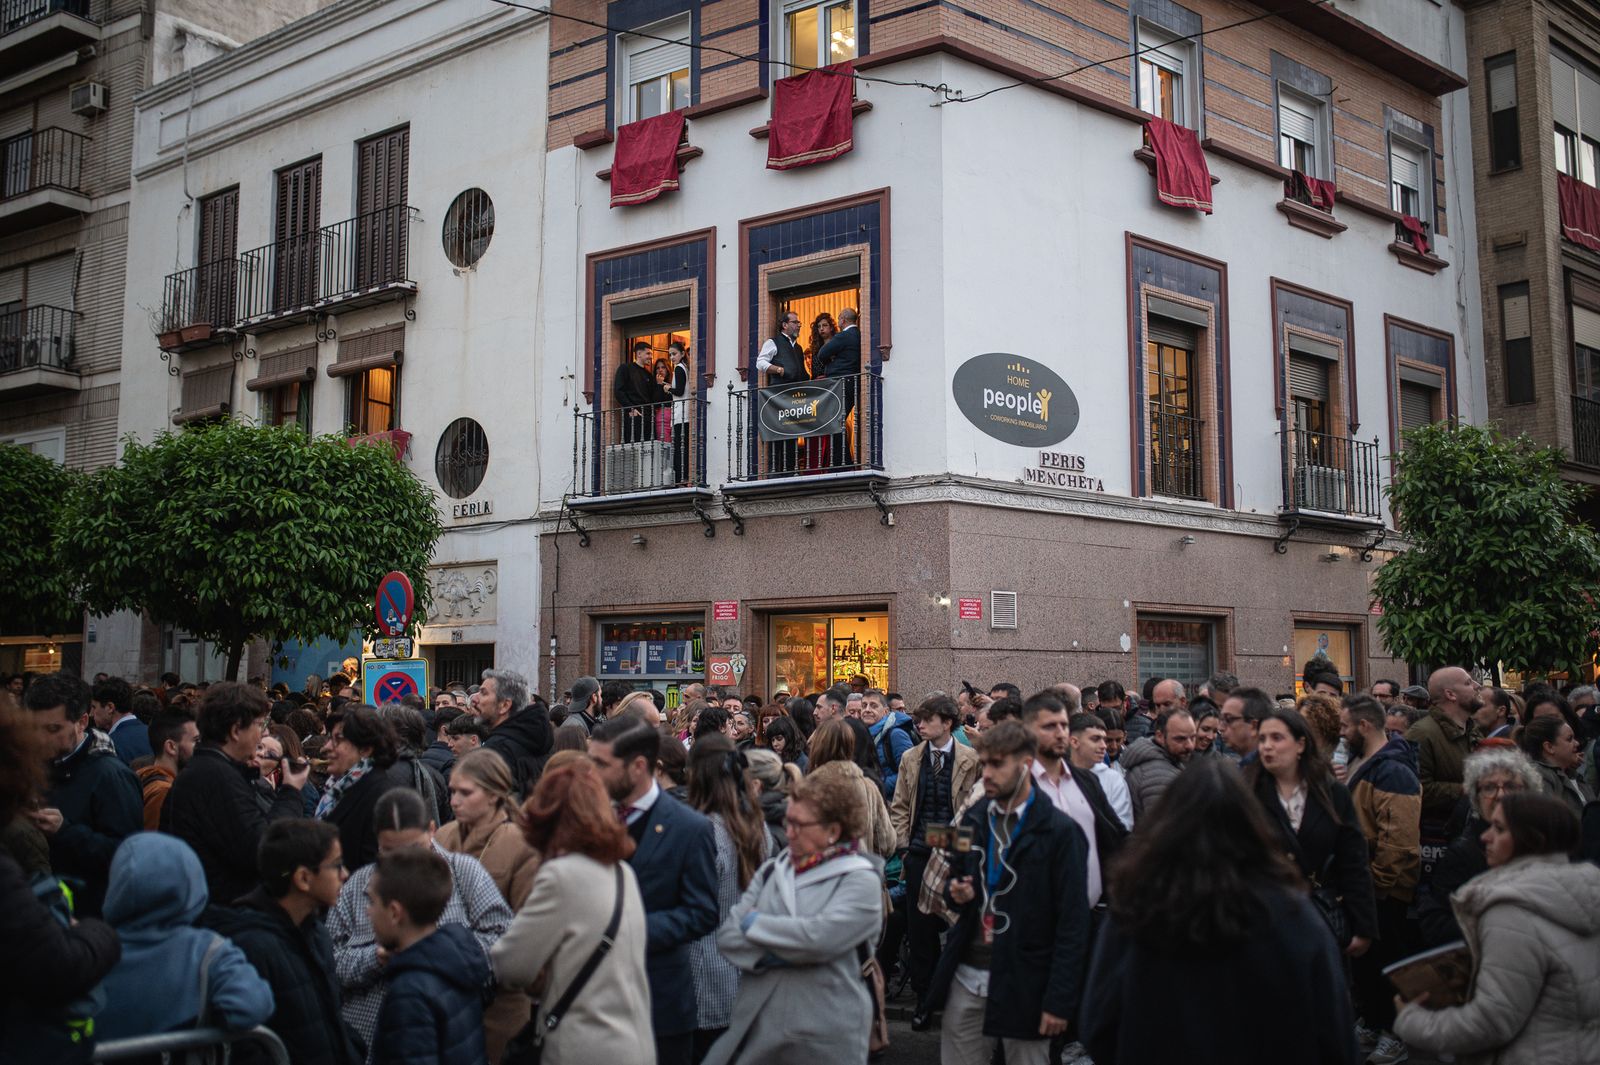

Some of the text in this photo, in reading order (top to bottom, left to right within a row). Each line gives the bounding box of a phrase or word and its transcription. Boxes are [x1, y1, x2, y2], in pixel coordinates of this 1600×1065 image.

[1007, 375, 1030, 388] HOME
[983, 388, 1042, 415] people
[778, 404, 812, 420] people
[990, 414, 1018, 425] COWORKING
[1042, 452, 1086, 470] PERIS
[1026, 468, 1104, 491] MENCHETA
